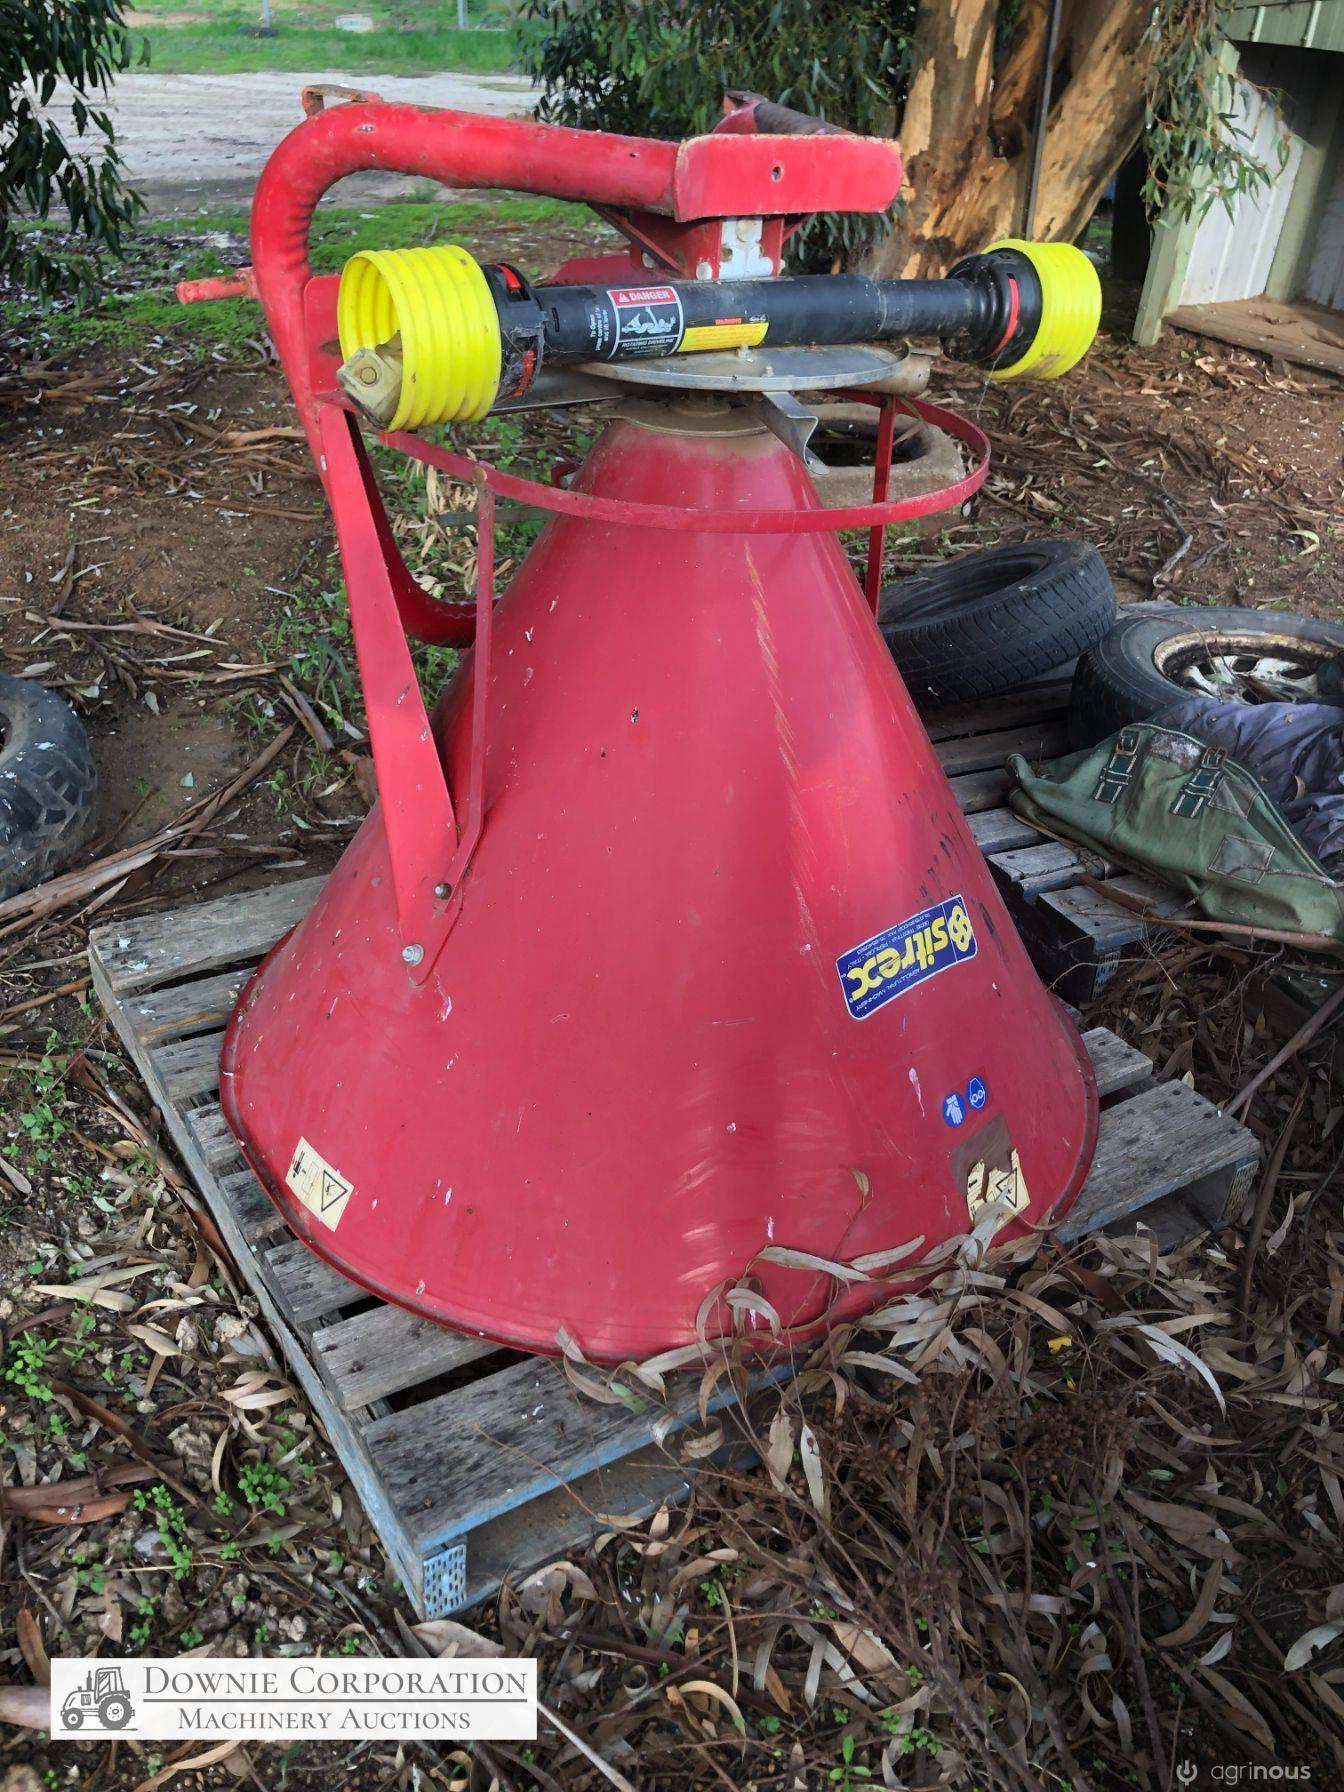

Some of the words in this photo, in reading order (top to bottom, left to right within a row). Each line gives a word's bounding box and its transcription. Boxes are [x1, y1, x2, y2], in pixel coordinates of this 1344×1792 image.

[630, 290, 670, 301] DANGER
[846, 916, 949, 1001] sitrex
[847, 957, 862, 970] ITALY
[887, 968, 920, 991] AGRICULTURAL
[856, 987, 886, 1011] MACHINERY
